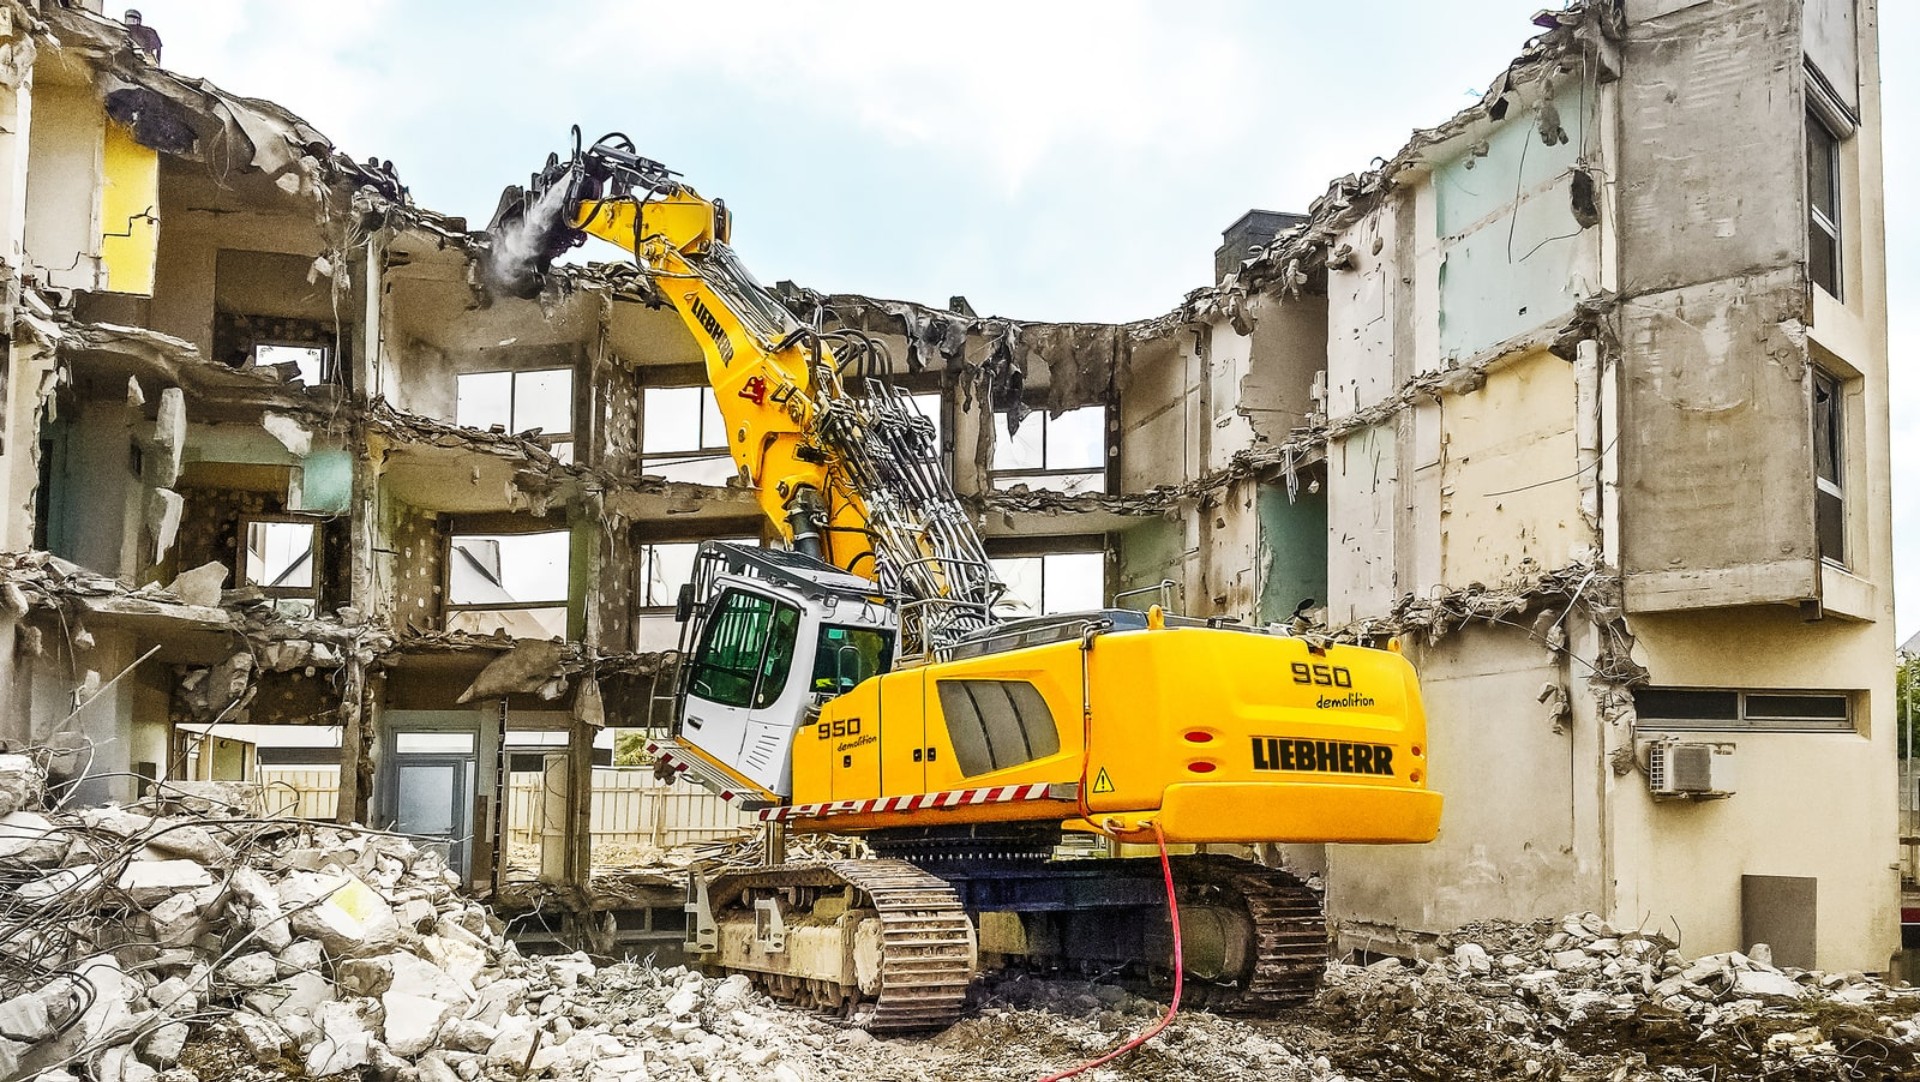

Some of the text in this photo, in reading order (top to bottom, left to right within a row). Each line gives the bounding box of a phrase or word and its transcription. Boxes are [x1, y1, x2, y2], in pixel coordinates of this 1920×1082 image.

[1291, 662, 1352, 688] 950
[1316, 692, 1375, 709] demolition
[818, 718, 861, 740] 950
[837, 734, 877, 752] demolition
[1251, 737, 1395, 776] LIEBHERR
